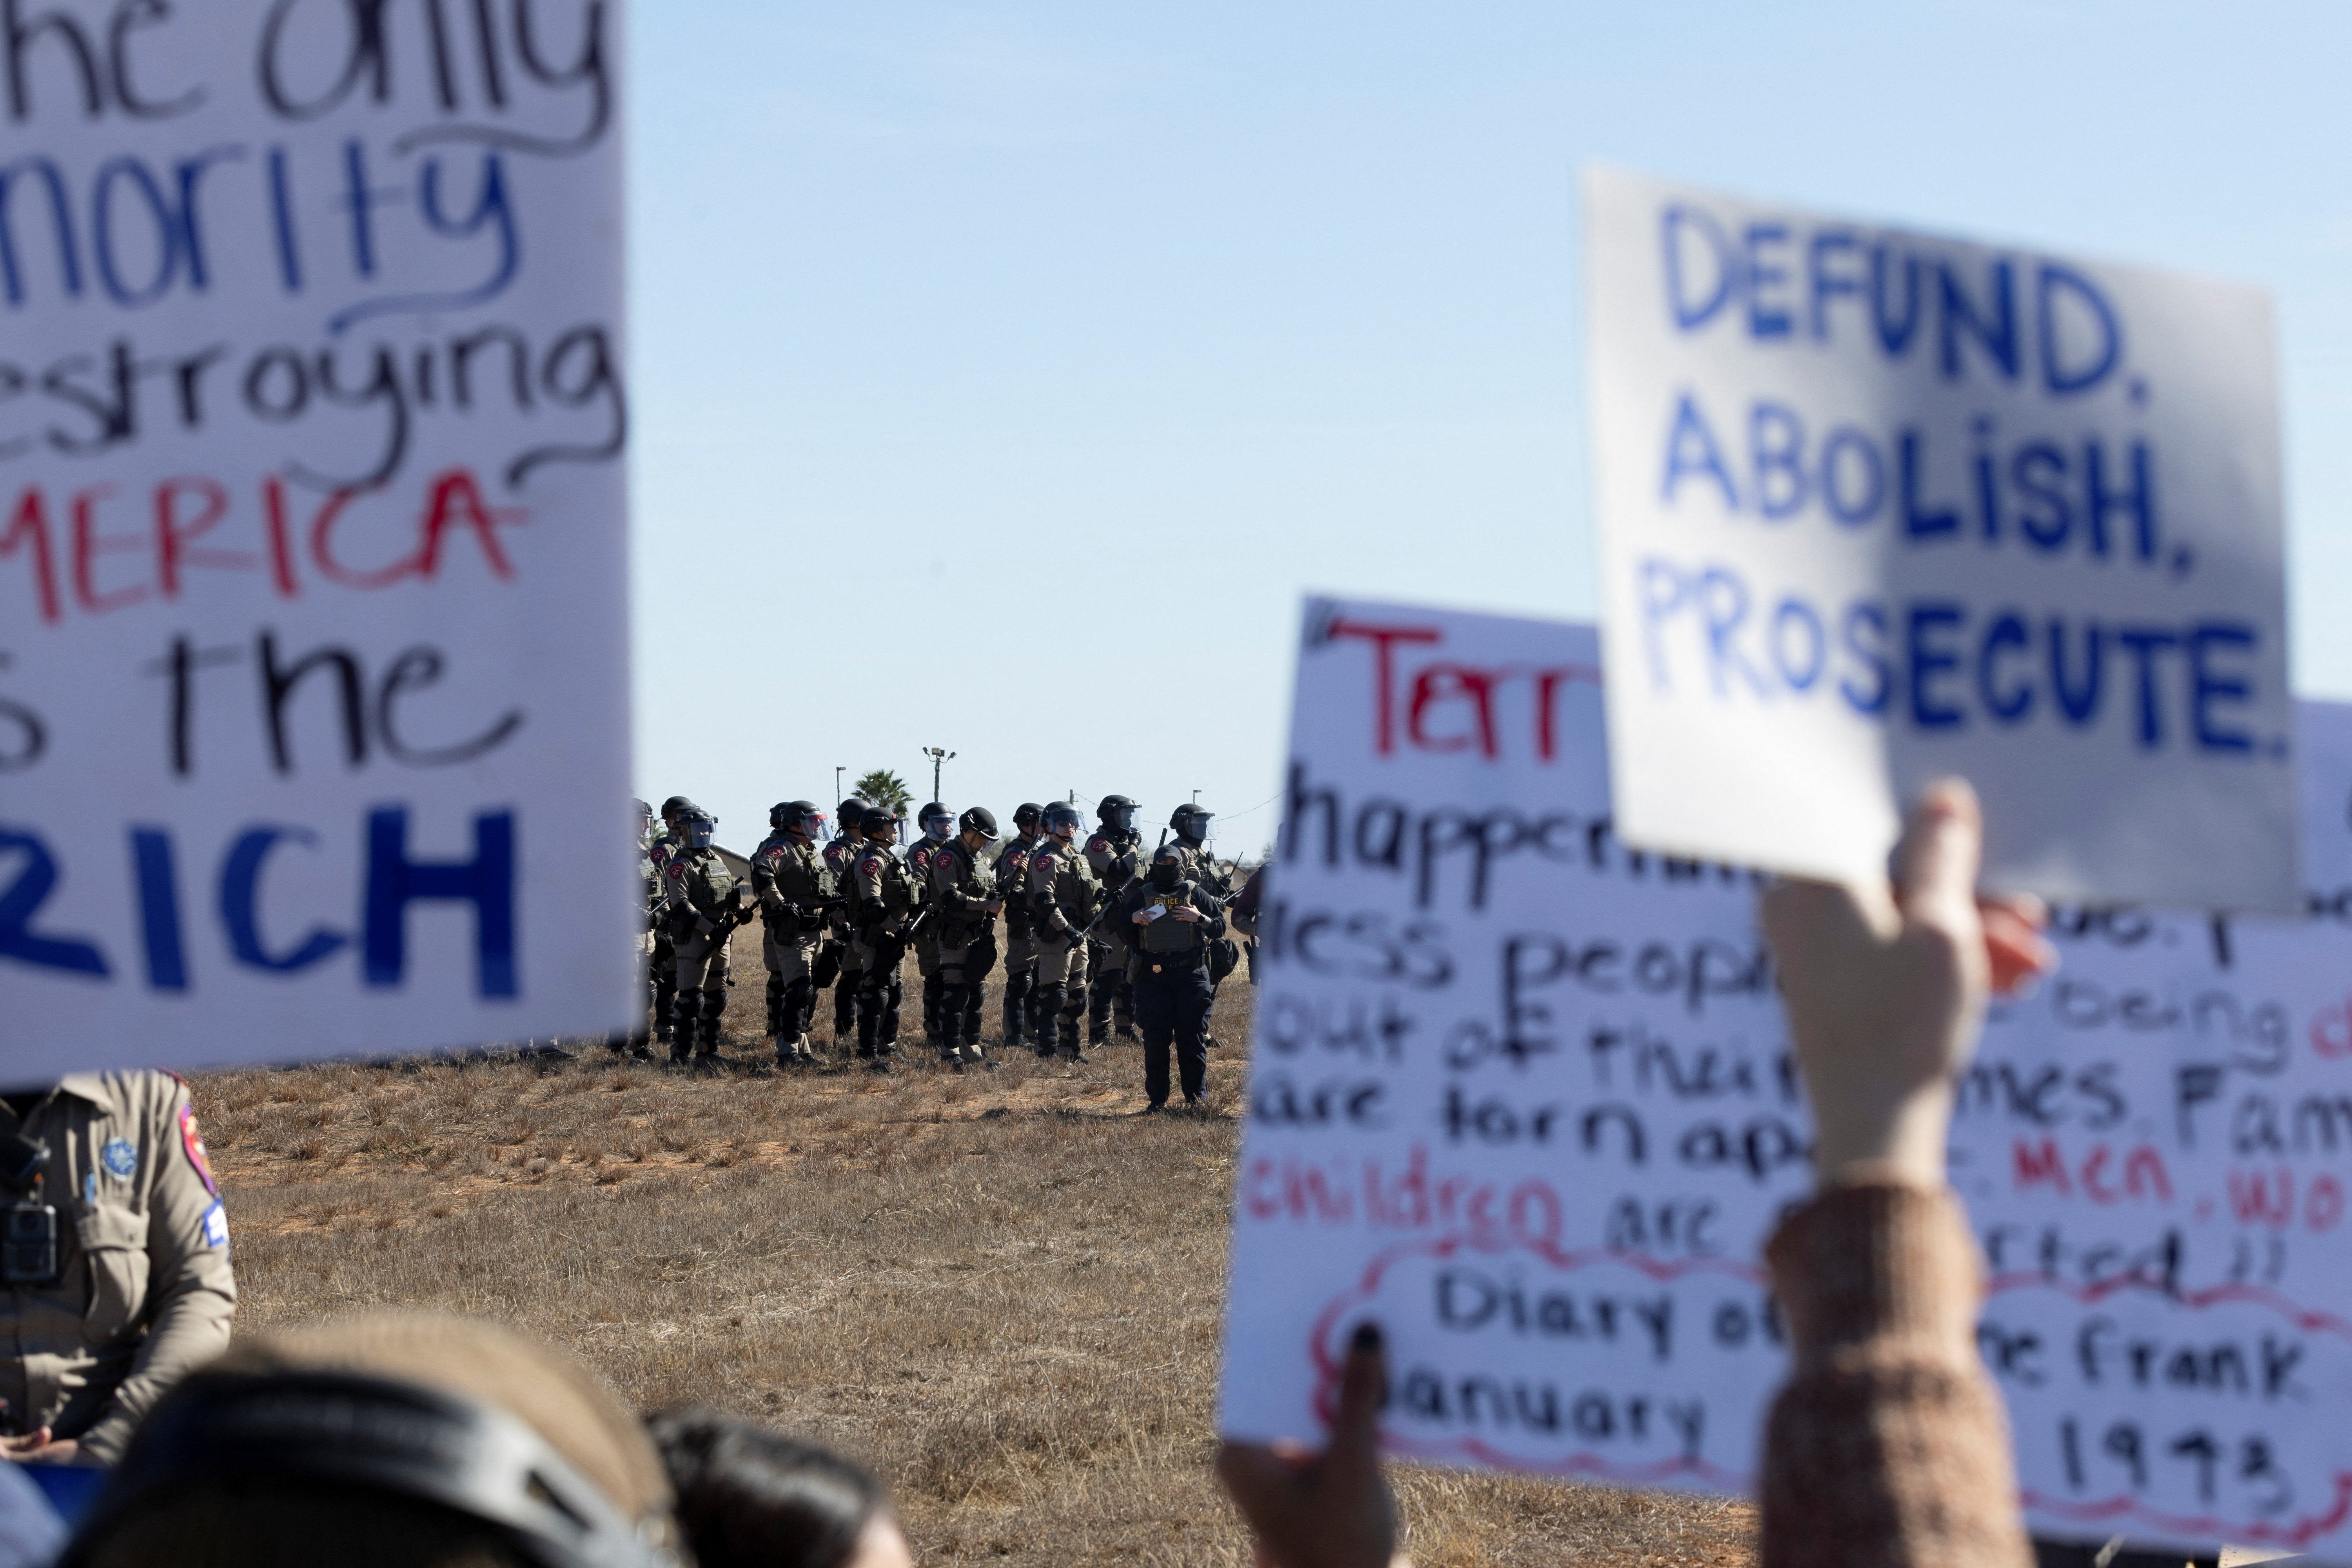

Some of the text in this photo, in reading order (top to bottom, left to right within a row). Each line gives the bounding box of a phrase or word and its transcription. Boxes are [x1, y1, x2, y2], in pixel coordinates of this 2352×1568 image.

[1660, 203, 2151, 404] DEFUND.
[142, 629, 526, 779] the
[1329, 617, 1601, 764] Terr
[1637, 555, 2290, 760] PROSECUTE.
[1279, 754, 1764, 912] happen
[1265, 994, 1416, 1066] out
[1443, 1002, 1561, 1076] of
[1504, 934, 1771, 1022] peop
[2050, 977, 2293, 1077] being
[1253, 1068, 1387, 1129] are
[1443, 1083, 1648, 1165] torn
[1607, 1192, 1721, 1259] are
[1435, 1263, 1674, 1365] Diary
[1974, 1319, 2048, 1388] ne
[1386, 1365, 1707, 1467] anuary
